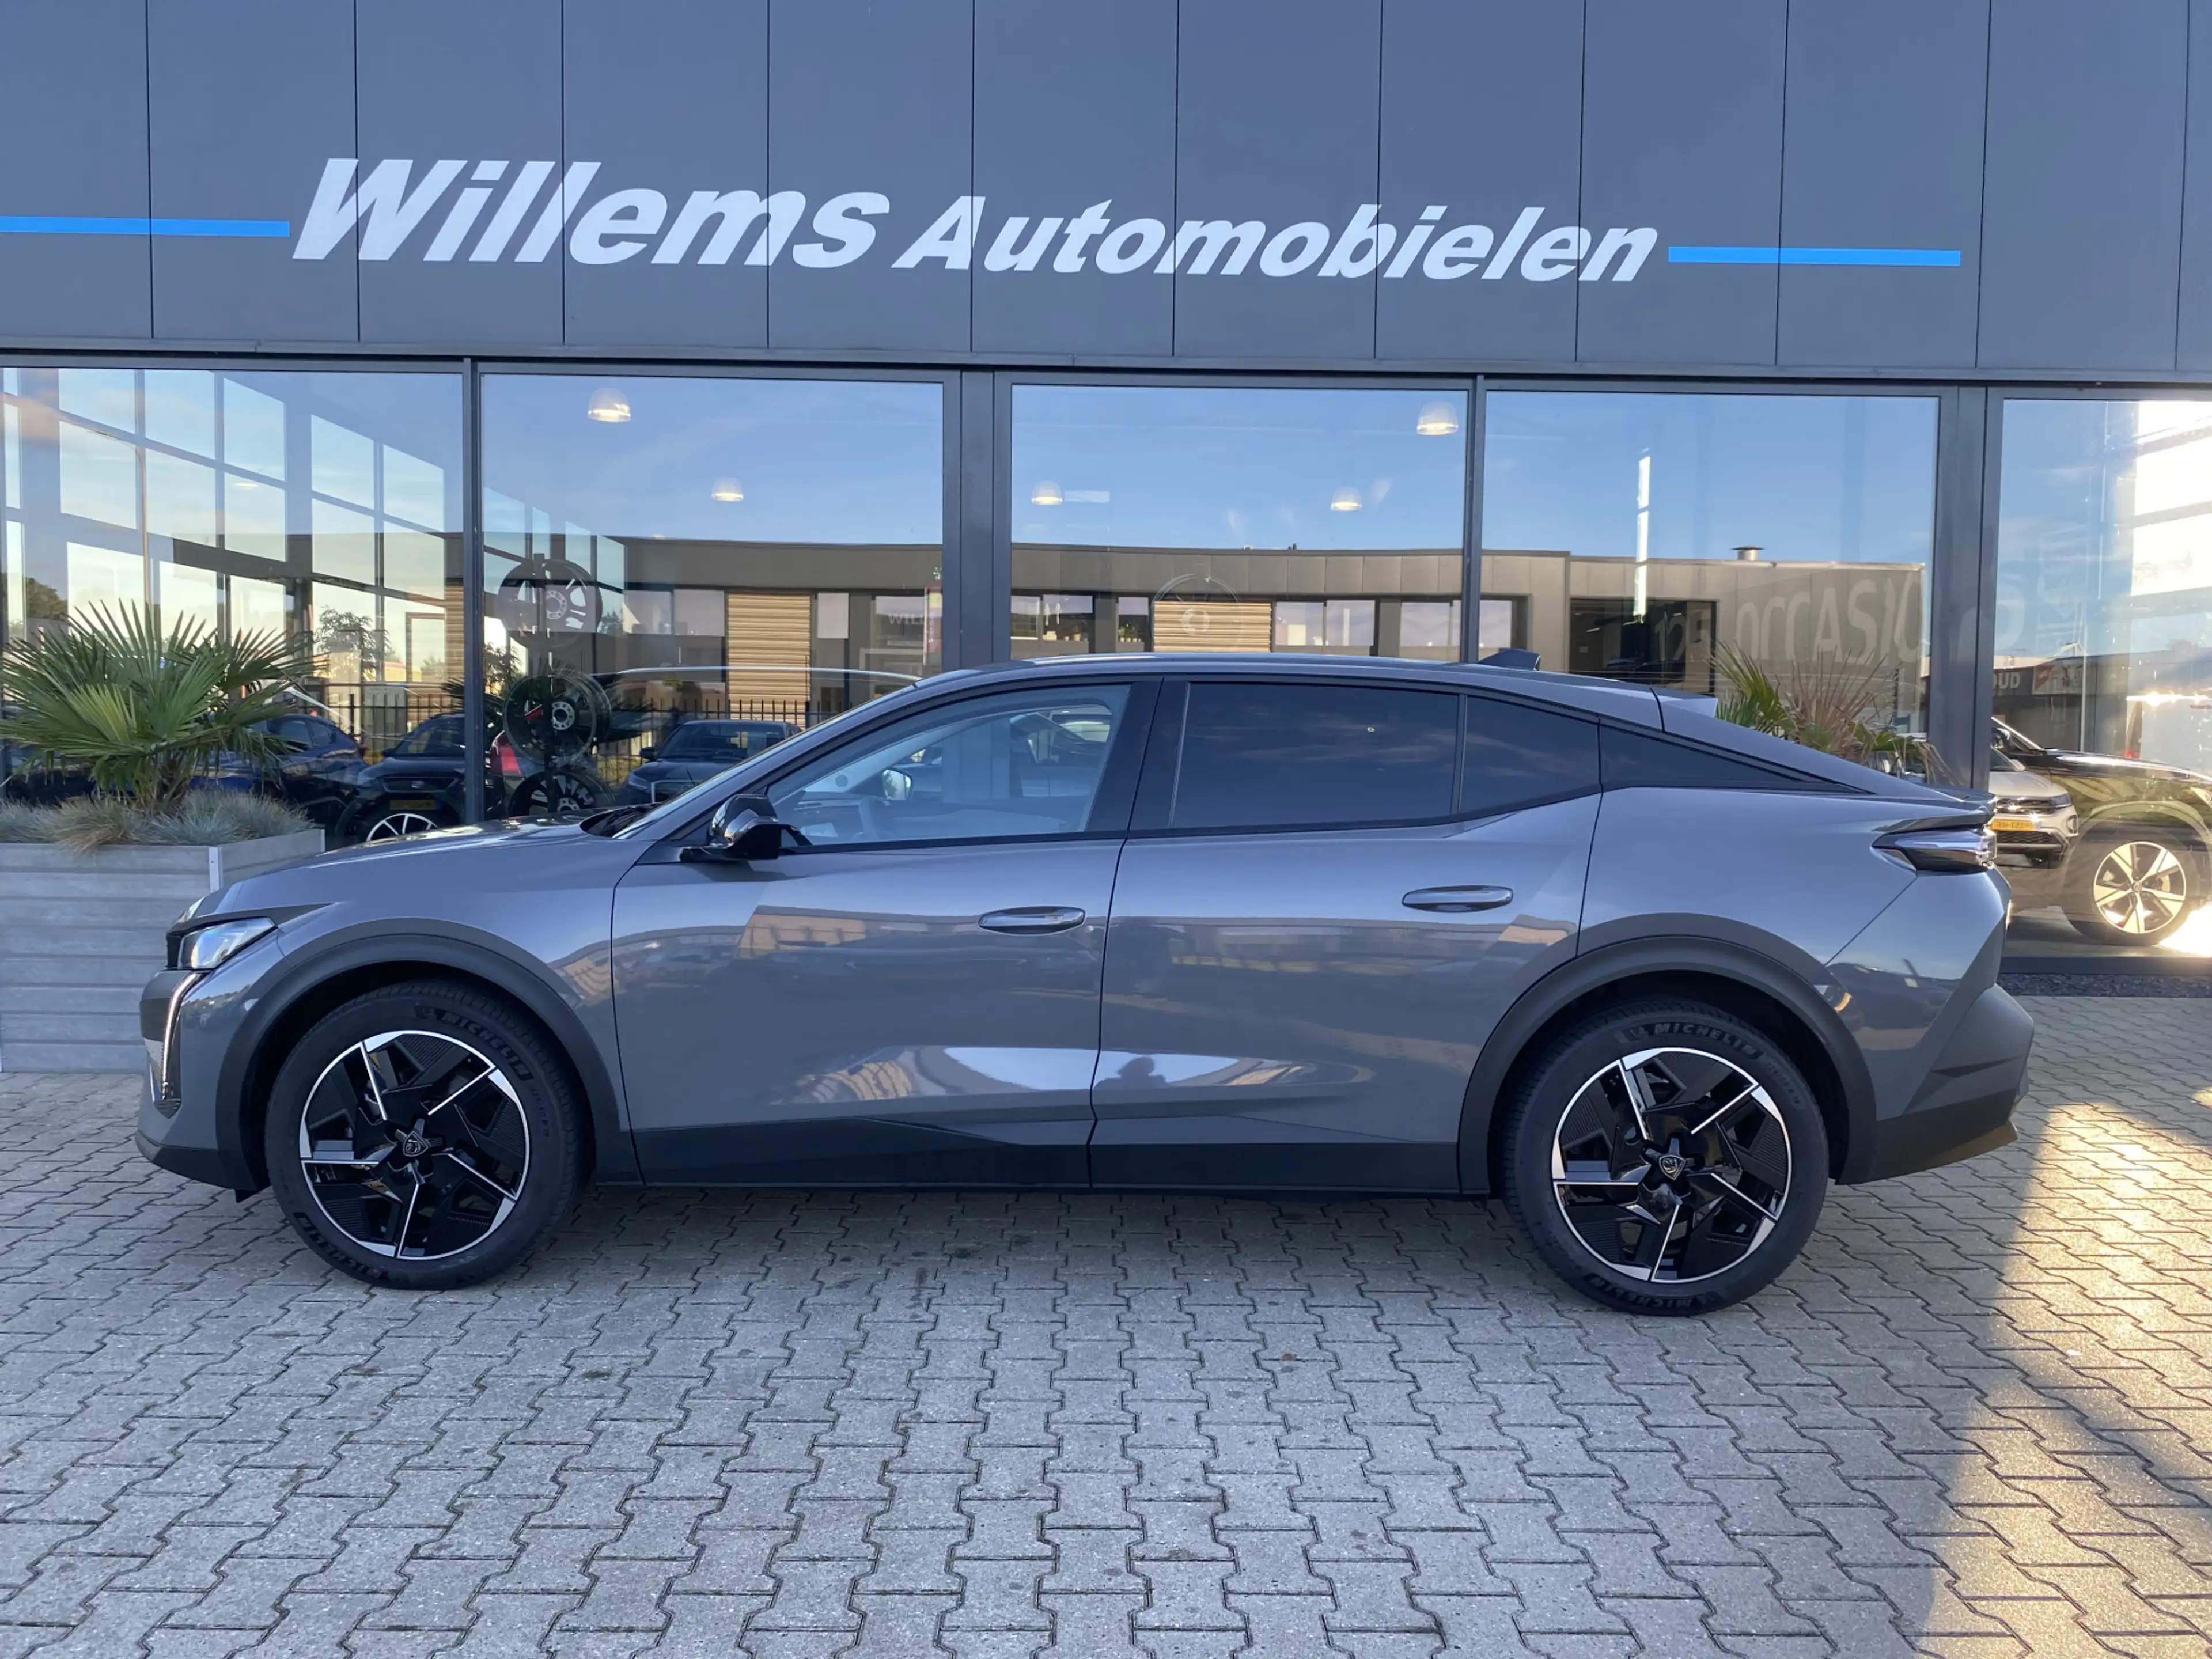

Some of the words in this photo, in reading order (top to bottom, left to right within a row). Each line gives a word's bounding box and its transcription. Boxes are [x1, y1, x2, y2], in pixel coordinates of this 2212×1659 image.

[293, 157, 890, 268] Willems
[892, 196, 1658, 282] Automobielen
[1654, 1022, 1758, 1056] MICHELIN
